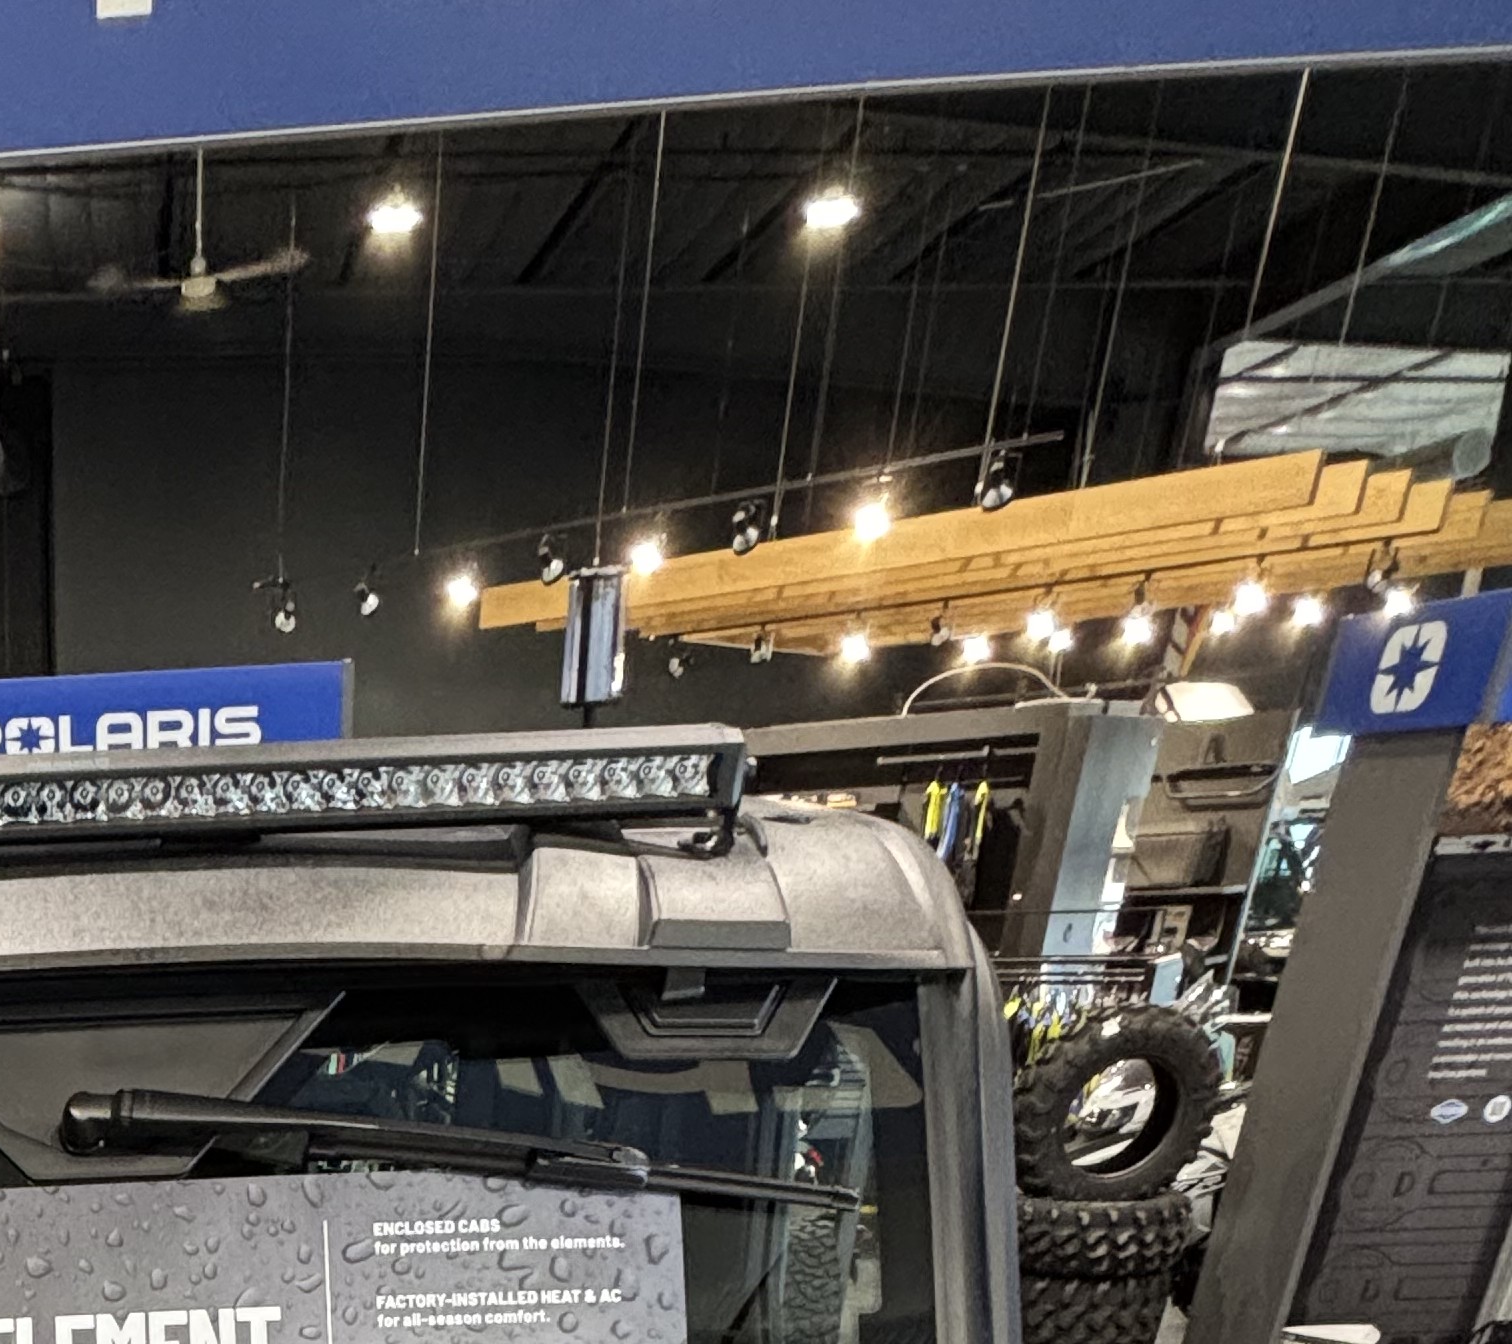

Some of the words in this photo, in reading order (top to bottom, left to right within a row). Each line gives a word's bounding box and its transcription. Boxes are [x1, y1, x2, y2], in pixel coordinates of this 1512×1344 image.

[373, 1220, 455, 1236] ENCLOSED
[458, 1218, 501, 1233] CABS
[374, 1240, 397, 1255] for
[400, 1237, 480, 1256] protection
[482, 1237, 520, 1252] from
[522, 1236, 548, 1250] the
[550, 1234, 626, 1250] elements.
[376, 1290, 538, 1310] FACTORY-INSTALLED
[540, 1289, 580, 1305] HEAT
[584, 1289, 596, 1304] &
[599, 1288, 622, 1303] AC
[377, 1314, 399, 1328] for
[402, 1312, 482, 1327] all-season
[485, 1308, 551, 1325] comfort.
